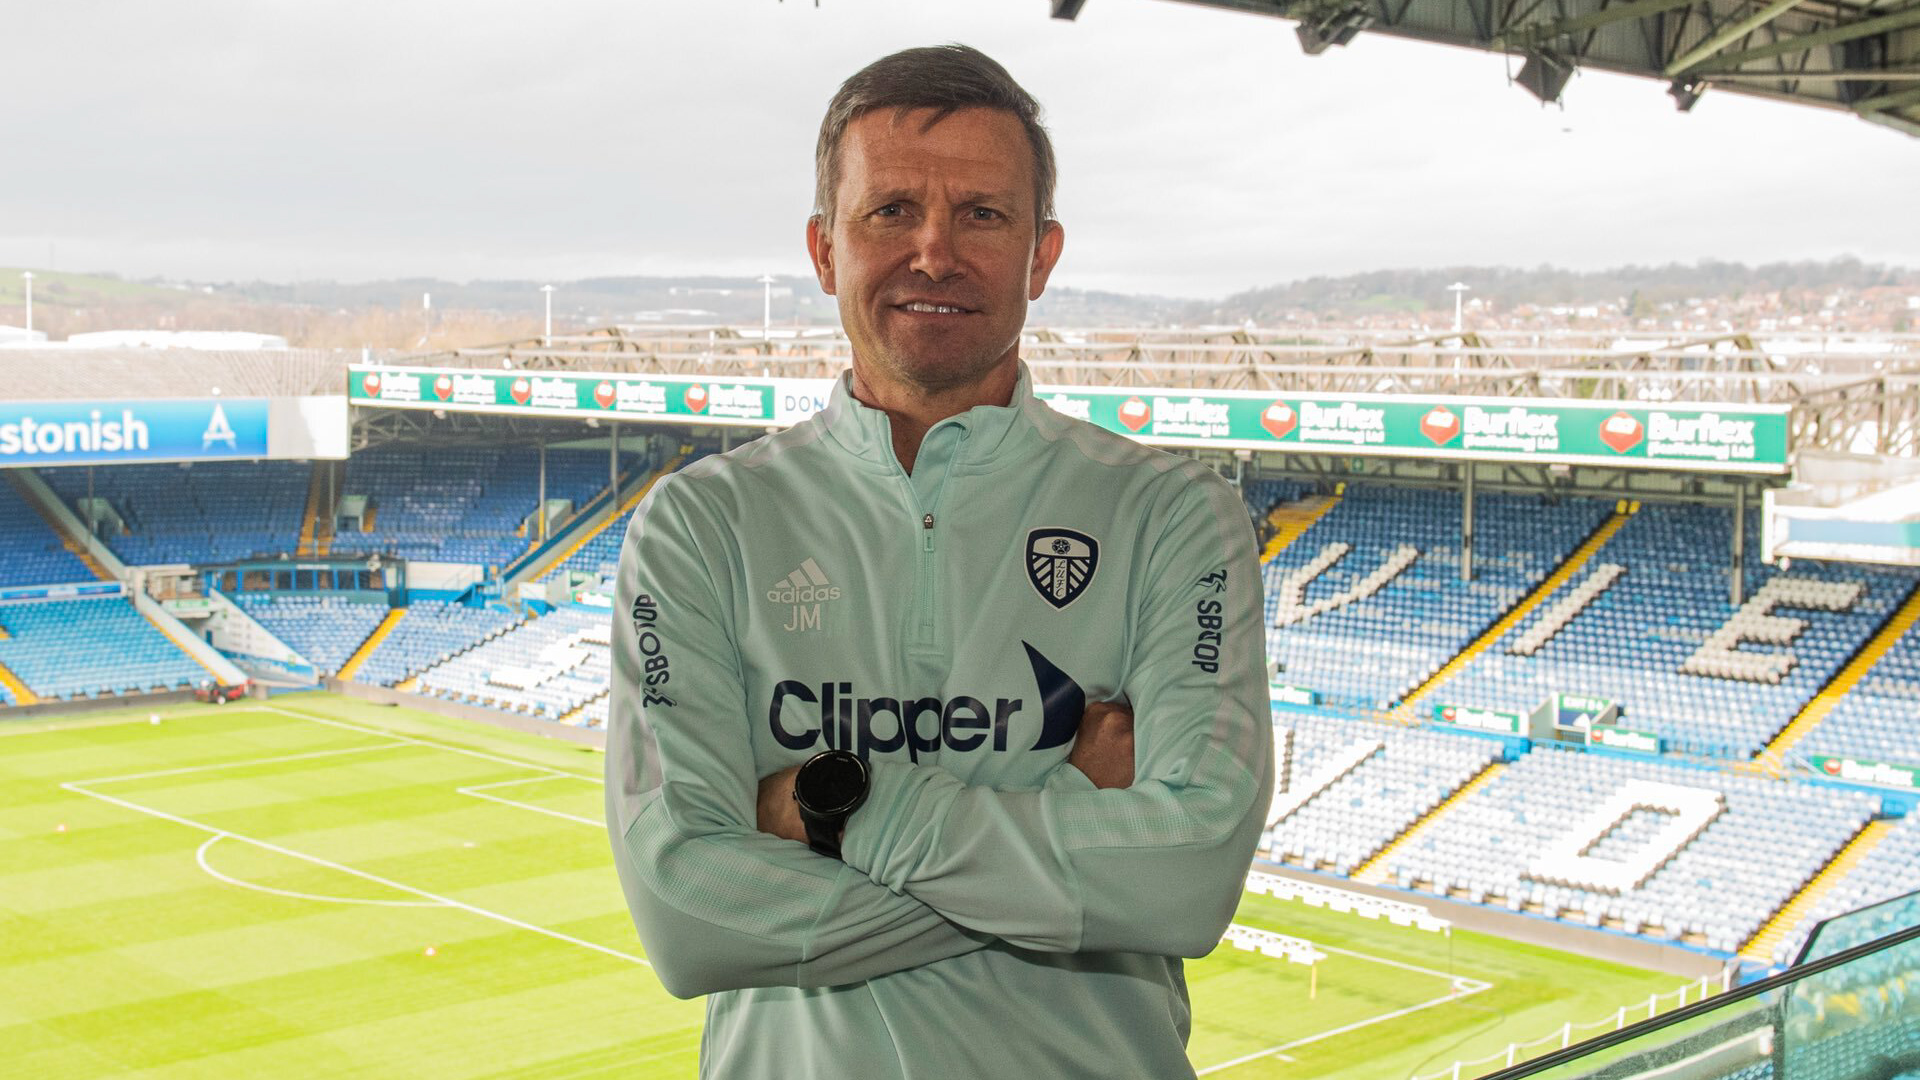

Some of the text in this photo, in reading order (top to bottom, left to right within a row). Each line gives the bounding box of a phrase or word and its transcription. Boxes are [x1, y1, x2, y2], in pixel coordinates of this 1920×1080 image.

[785, 395, 824, 412] DON
[1153, 397, 1229, 425] Burflex
[1300, 401, 1385, 431] Burflex
[1463, 406, 1559, 437] Burflex
[1648, 412, 1755, 443] Burflex
[766, 586, 841, 604] adidas
[783, 603, 822, 632] JM
[633, 594, 670, 686] SBOTOP
[769, 679, 1023, 766] Clipper
